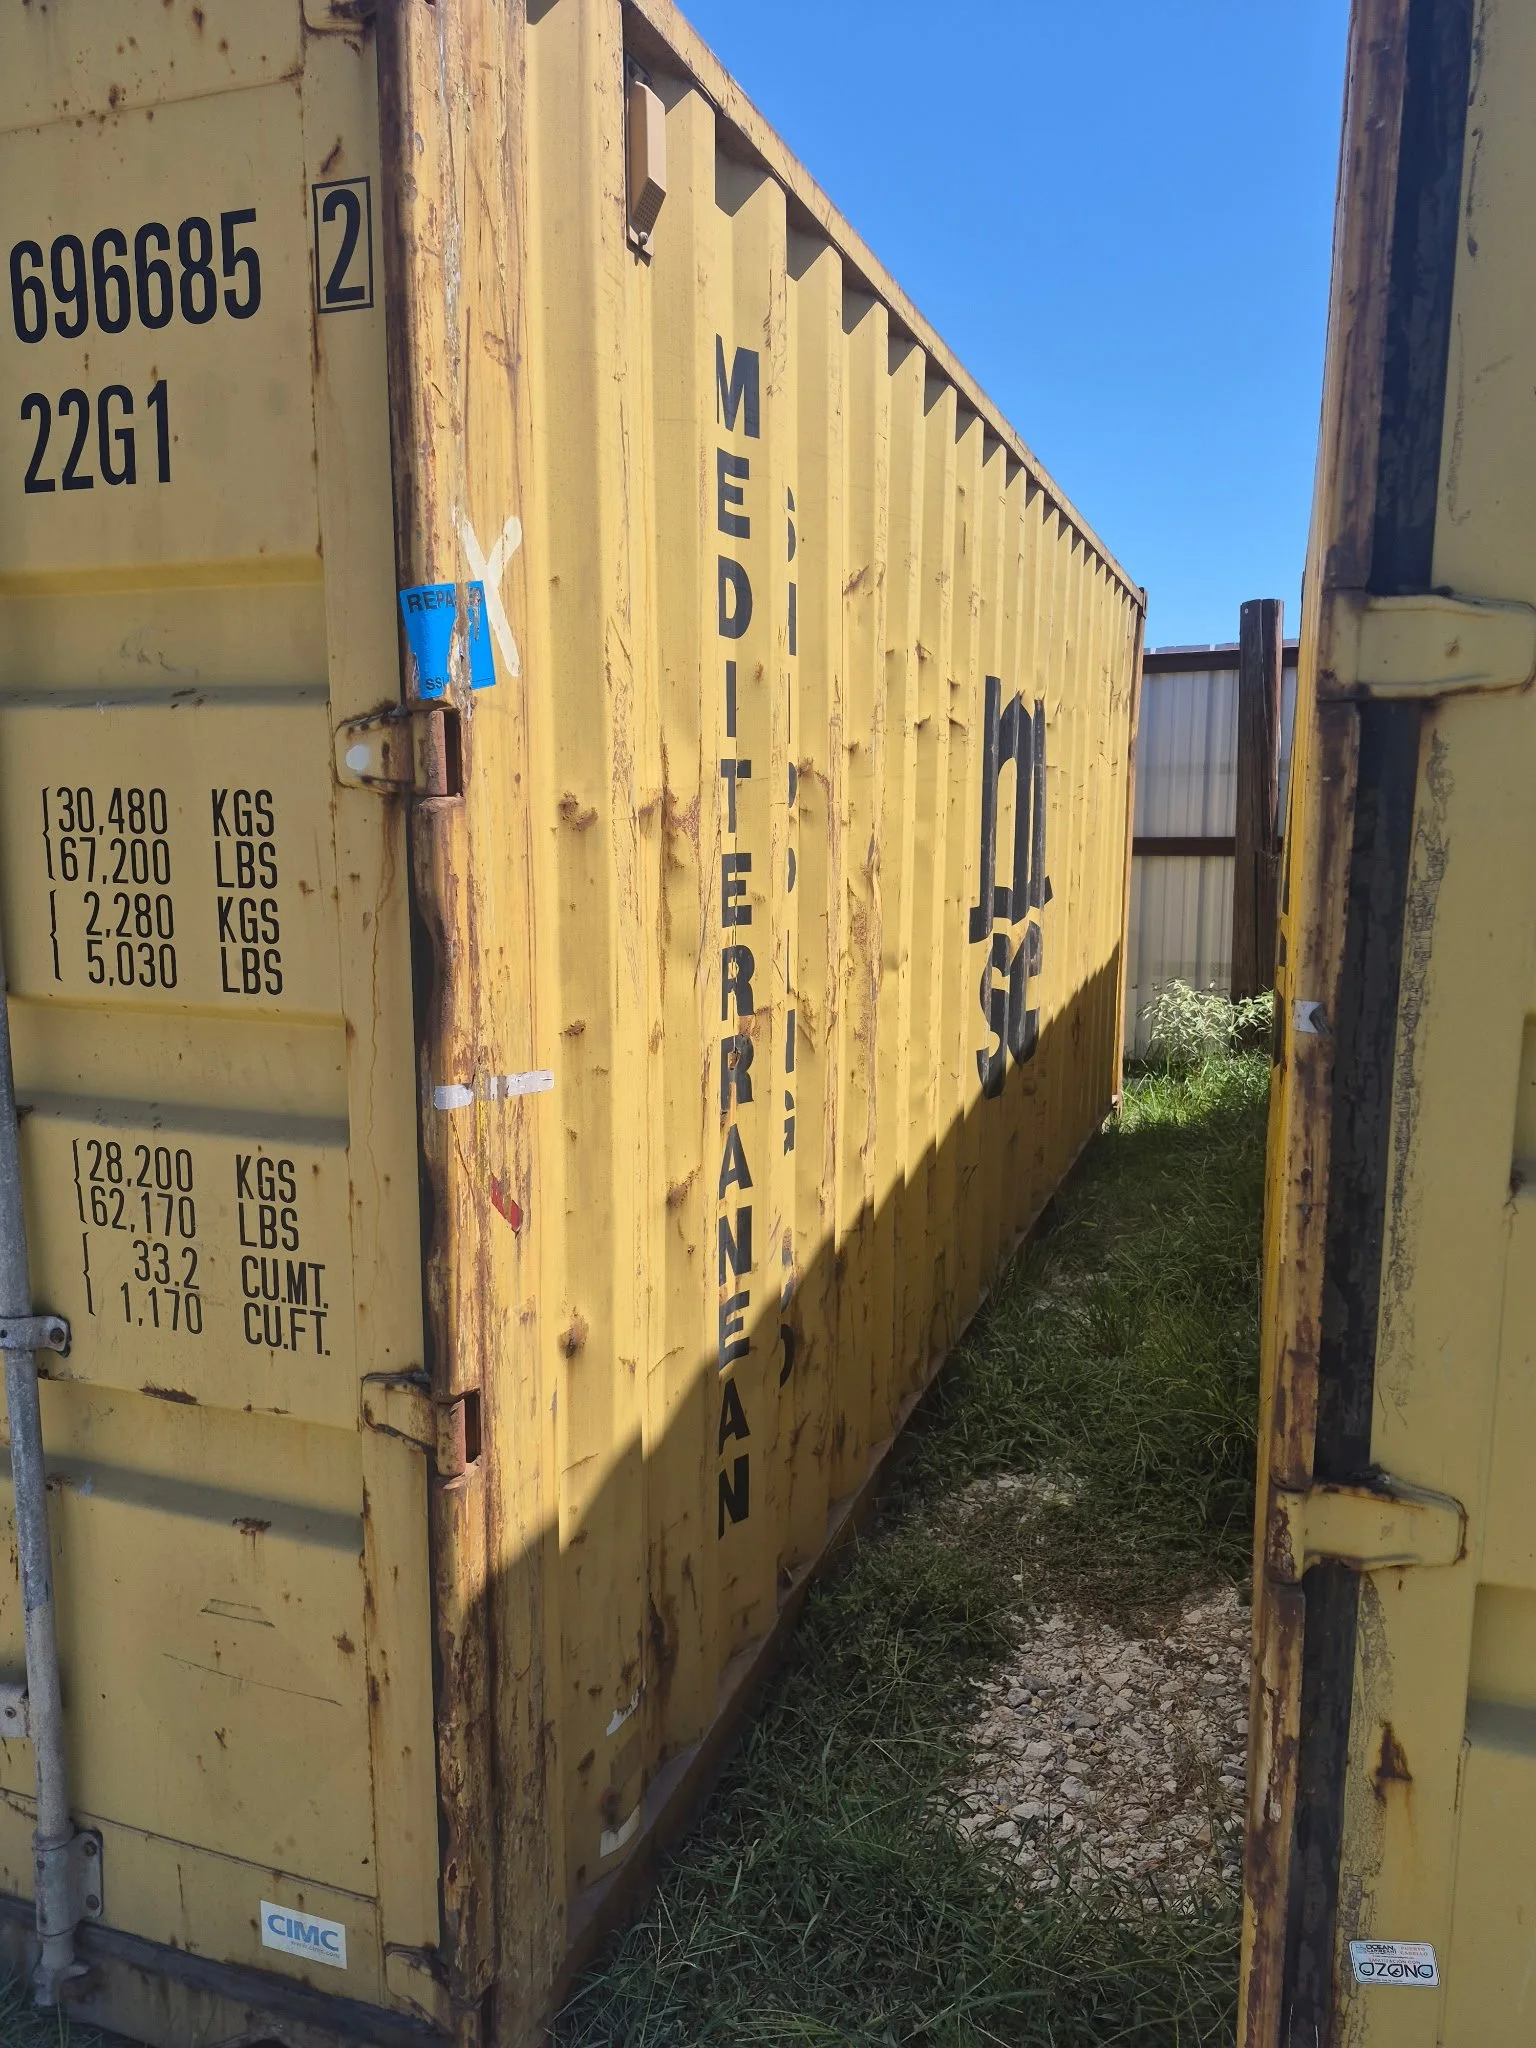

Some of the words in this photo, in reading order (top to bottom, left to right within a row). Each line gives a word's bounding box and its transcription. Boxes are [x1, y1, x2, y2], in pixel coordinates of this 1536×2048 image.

[9, 207, 262, 344] 696685
[322, 188, 366, 305] 2
[20, 379, 171, 494] 22G1
[406, 586, 483, 615] REPA
[56, 786, 168, 835] 30,480
[211, 788, 275, 837] KGS
[59, 836, 171, 885] 67,200
[214, 840, 278, 889] LBS
[83, 890, 174, 940] 2,280
[217, 895, 280, 945] KGS
[715, 332, 761, 1541] MEDITERRANEAN
[87, 939, 178, 988] 5,030
[220, 946, 283, 996] LBS
[86, 1139, 194, 1192] 28,200
[235, 1154, 297, 1203] KGS
[90, 1185, 196, 1239] 62,170
[238, 1202, 300, 1252] LBS
[132, 1239, 200, 1290] 33.2
[241, 1255, 329, 1309] CU.MT.
[120, 1282, 203, 1334] 1,170
[243, 1302, 331, 1356] CU.FT.
[267, 1914, 339, 1952] CIMC
[1359, 1962, 1434, 1979] OZONO
